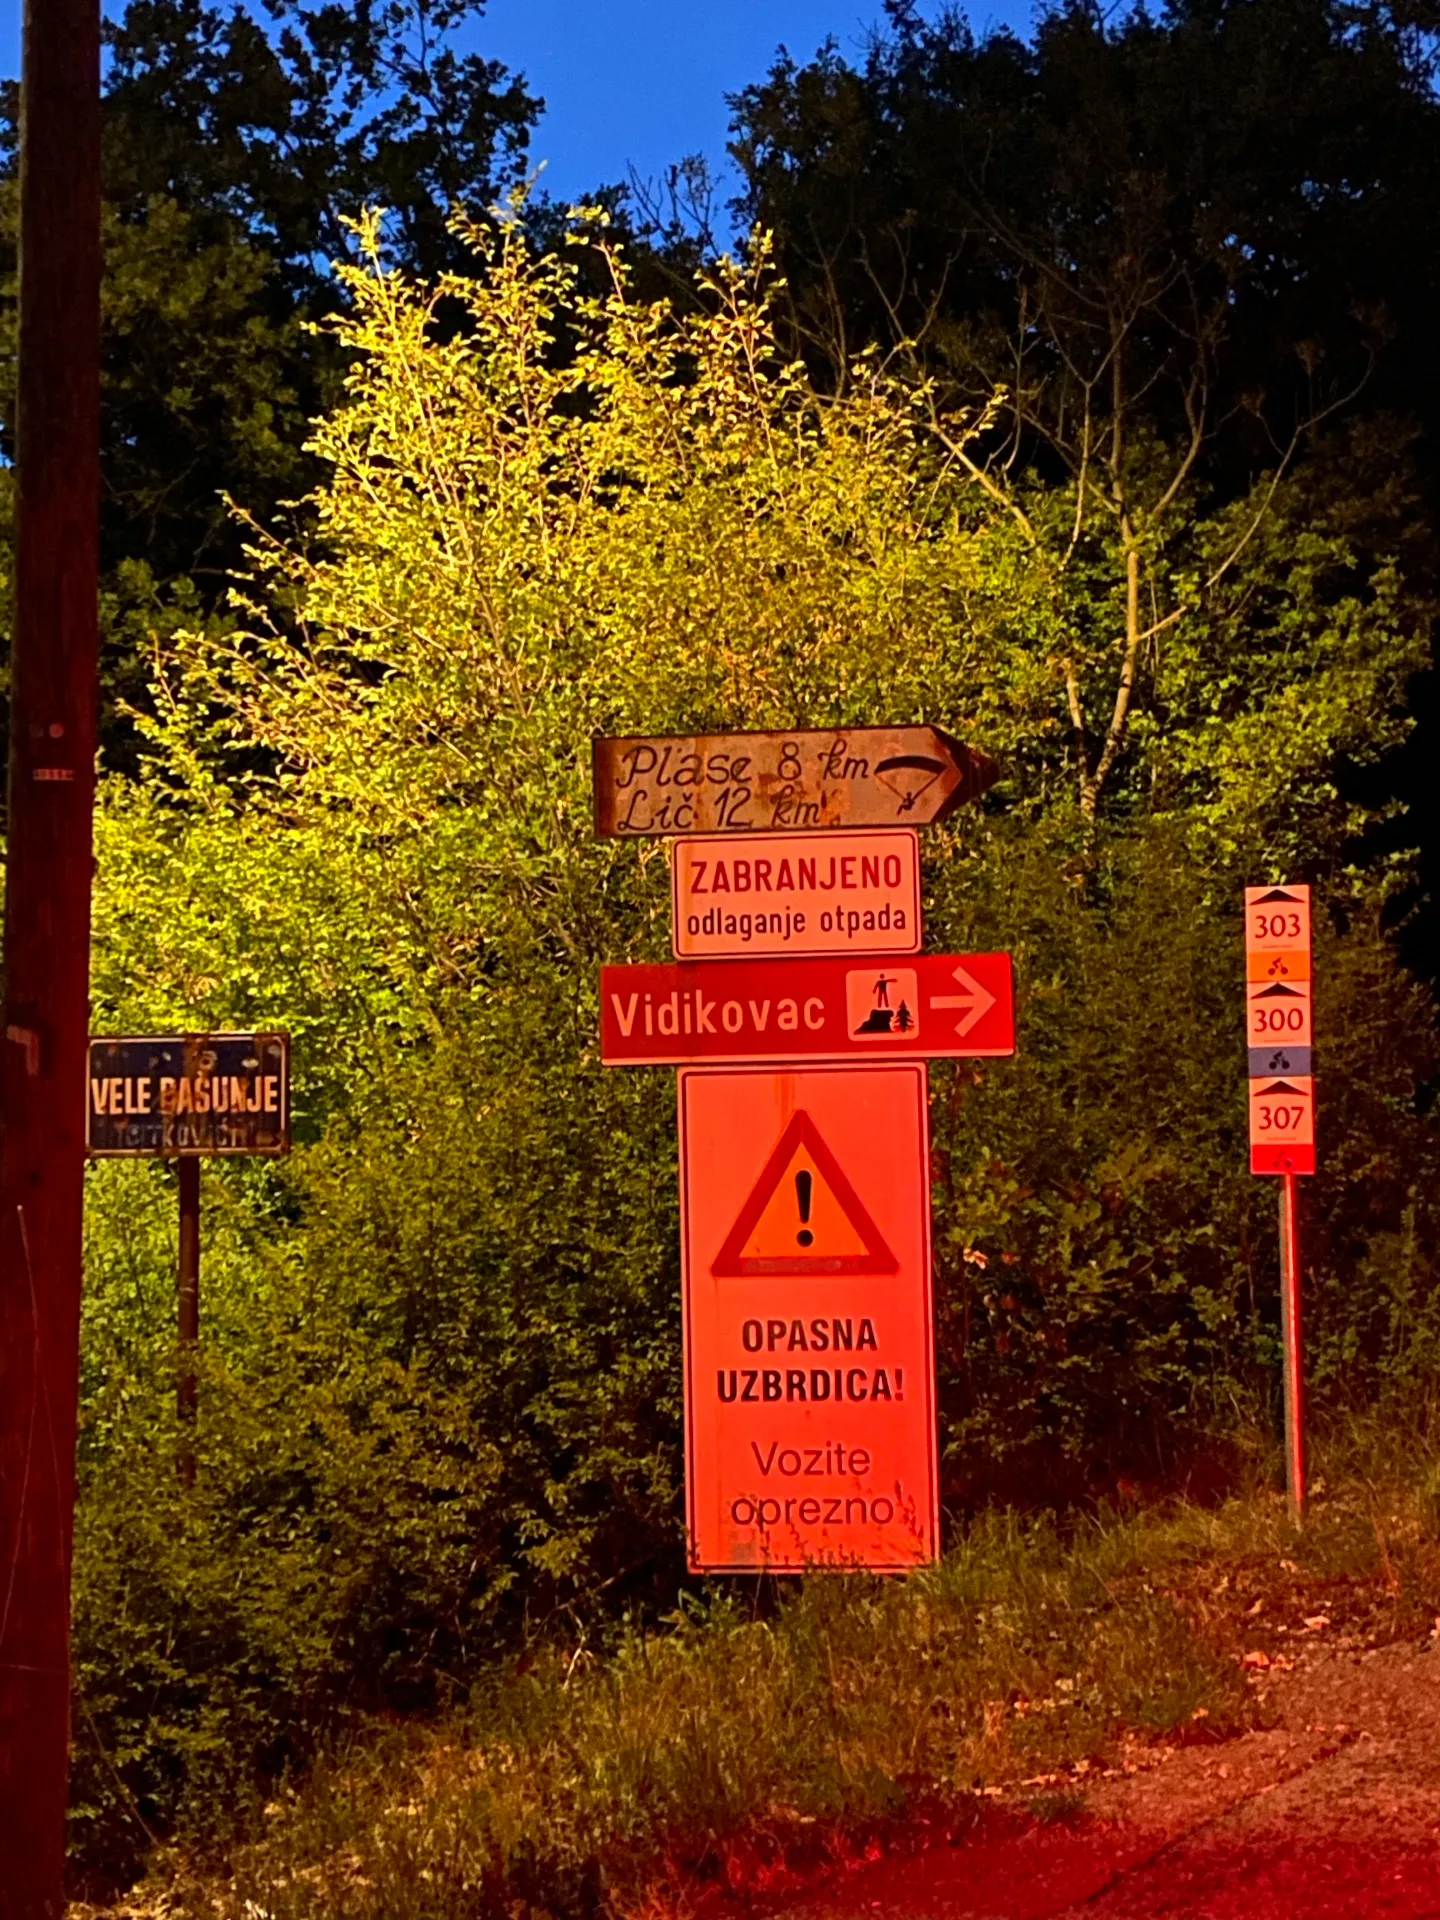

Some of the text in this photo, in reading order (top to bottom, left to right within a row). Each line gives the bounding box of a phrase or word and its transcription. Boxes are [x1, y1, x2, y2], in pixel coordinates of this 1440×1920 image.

[616, 739, 869, 788] Plase 8 km
[617, 785, 820, 831] Lič 12 km
[690, 854, 902, 894] ZABRANJENO
[687, 903, 907, 942] odlaganje otpada
[1254, 914, 1301, 938] 303
[611, 989, 825, 1037] Vidikovac
[1254, 1008, 1304, 1032] 300
[91, 1077, 151, 1115] VELE
[1258, 1106, 1304, 1130] 307
[742, 1319, 878, 1352] OPASNA
[717, 1368, 904, 1403] UZBRDICA!
[751, 1440, 870, 1476] Vozite
[731, 1496, 894, 1531] oprezno
